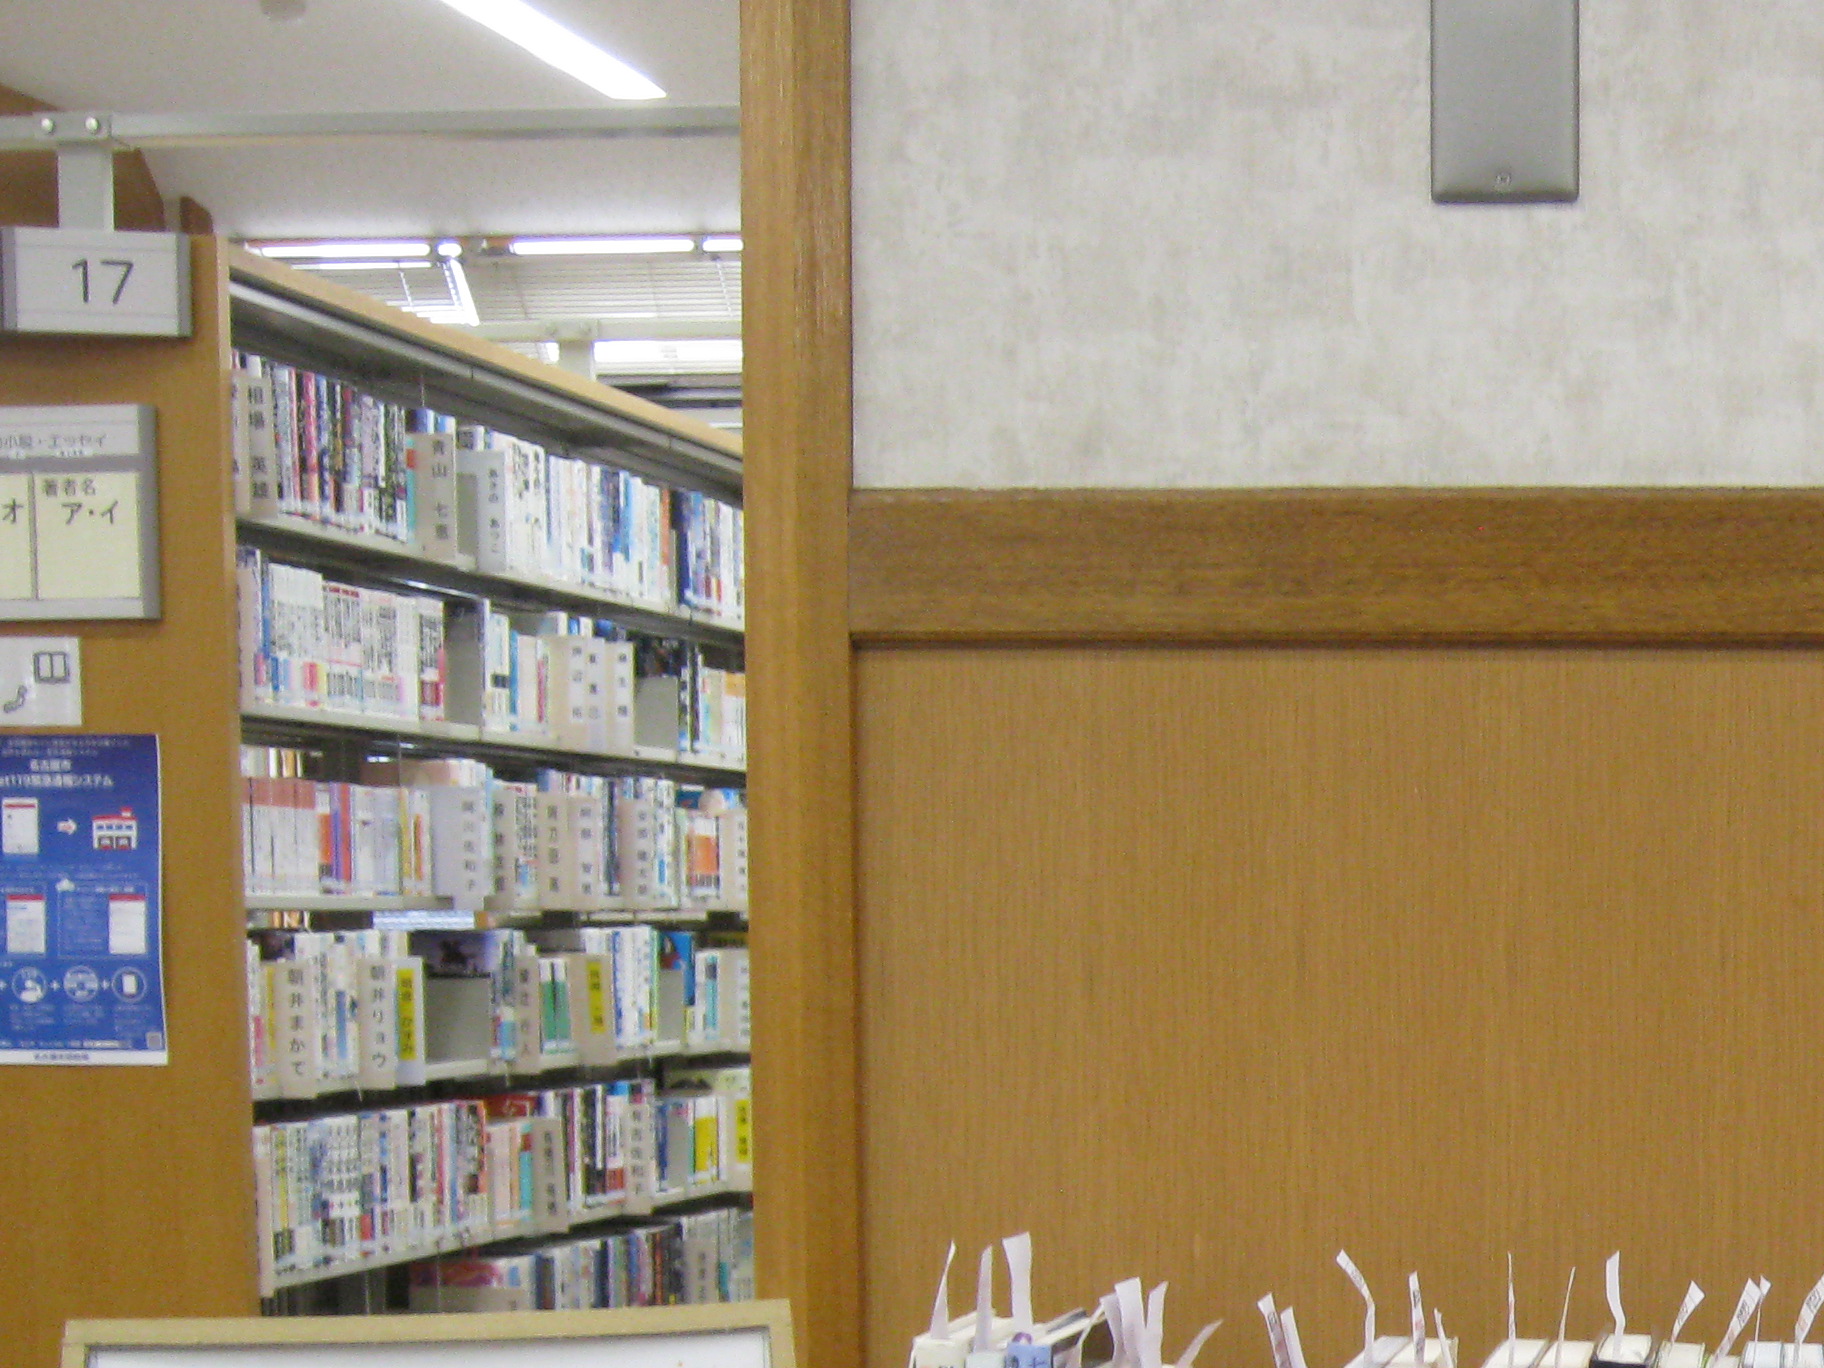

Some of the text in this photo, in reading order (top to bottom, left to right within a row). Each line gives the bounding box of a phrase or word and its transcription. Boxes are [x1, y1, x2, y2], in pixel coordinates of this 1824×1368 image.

[71, 260, 135, 305] 17
[0, 433, 107, 449] 小説・エッセイ
[62, 501, 118, 525] ア・イ
